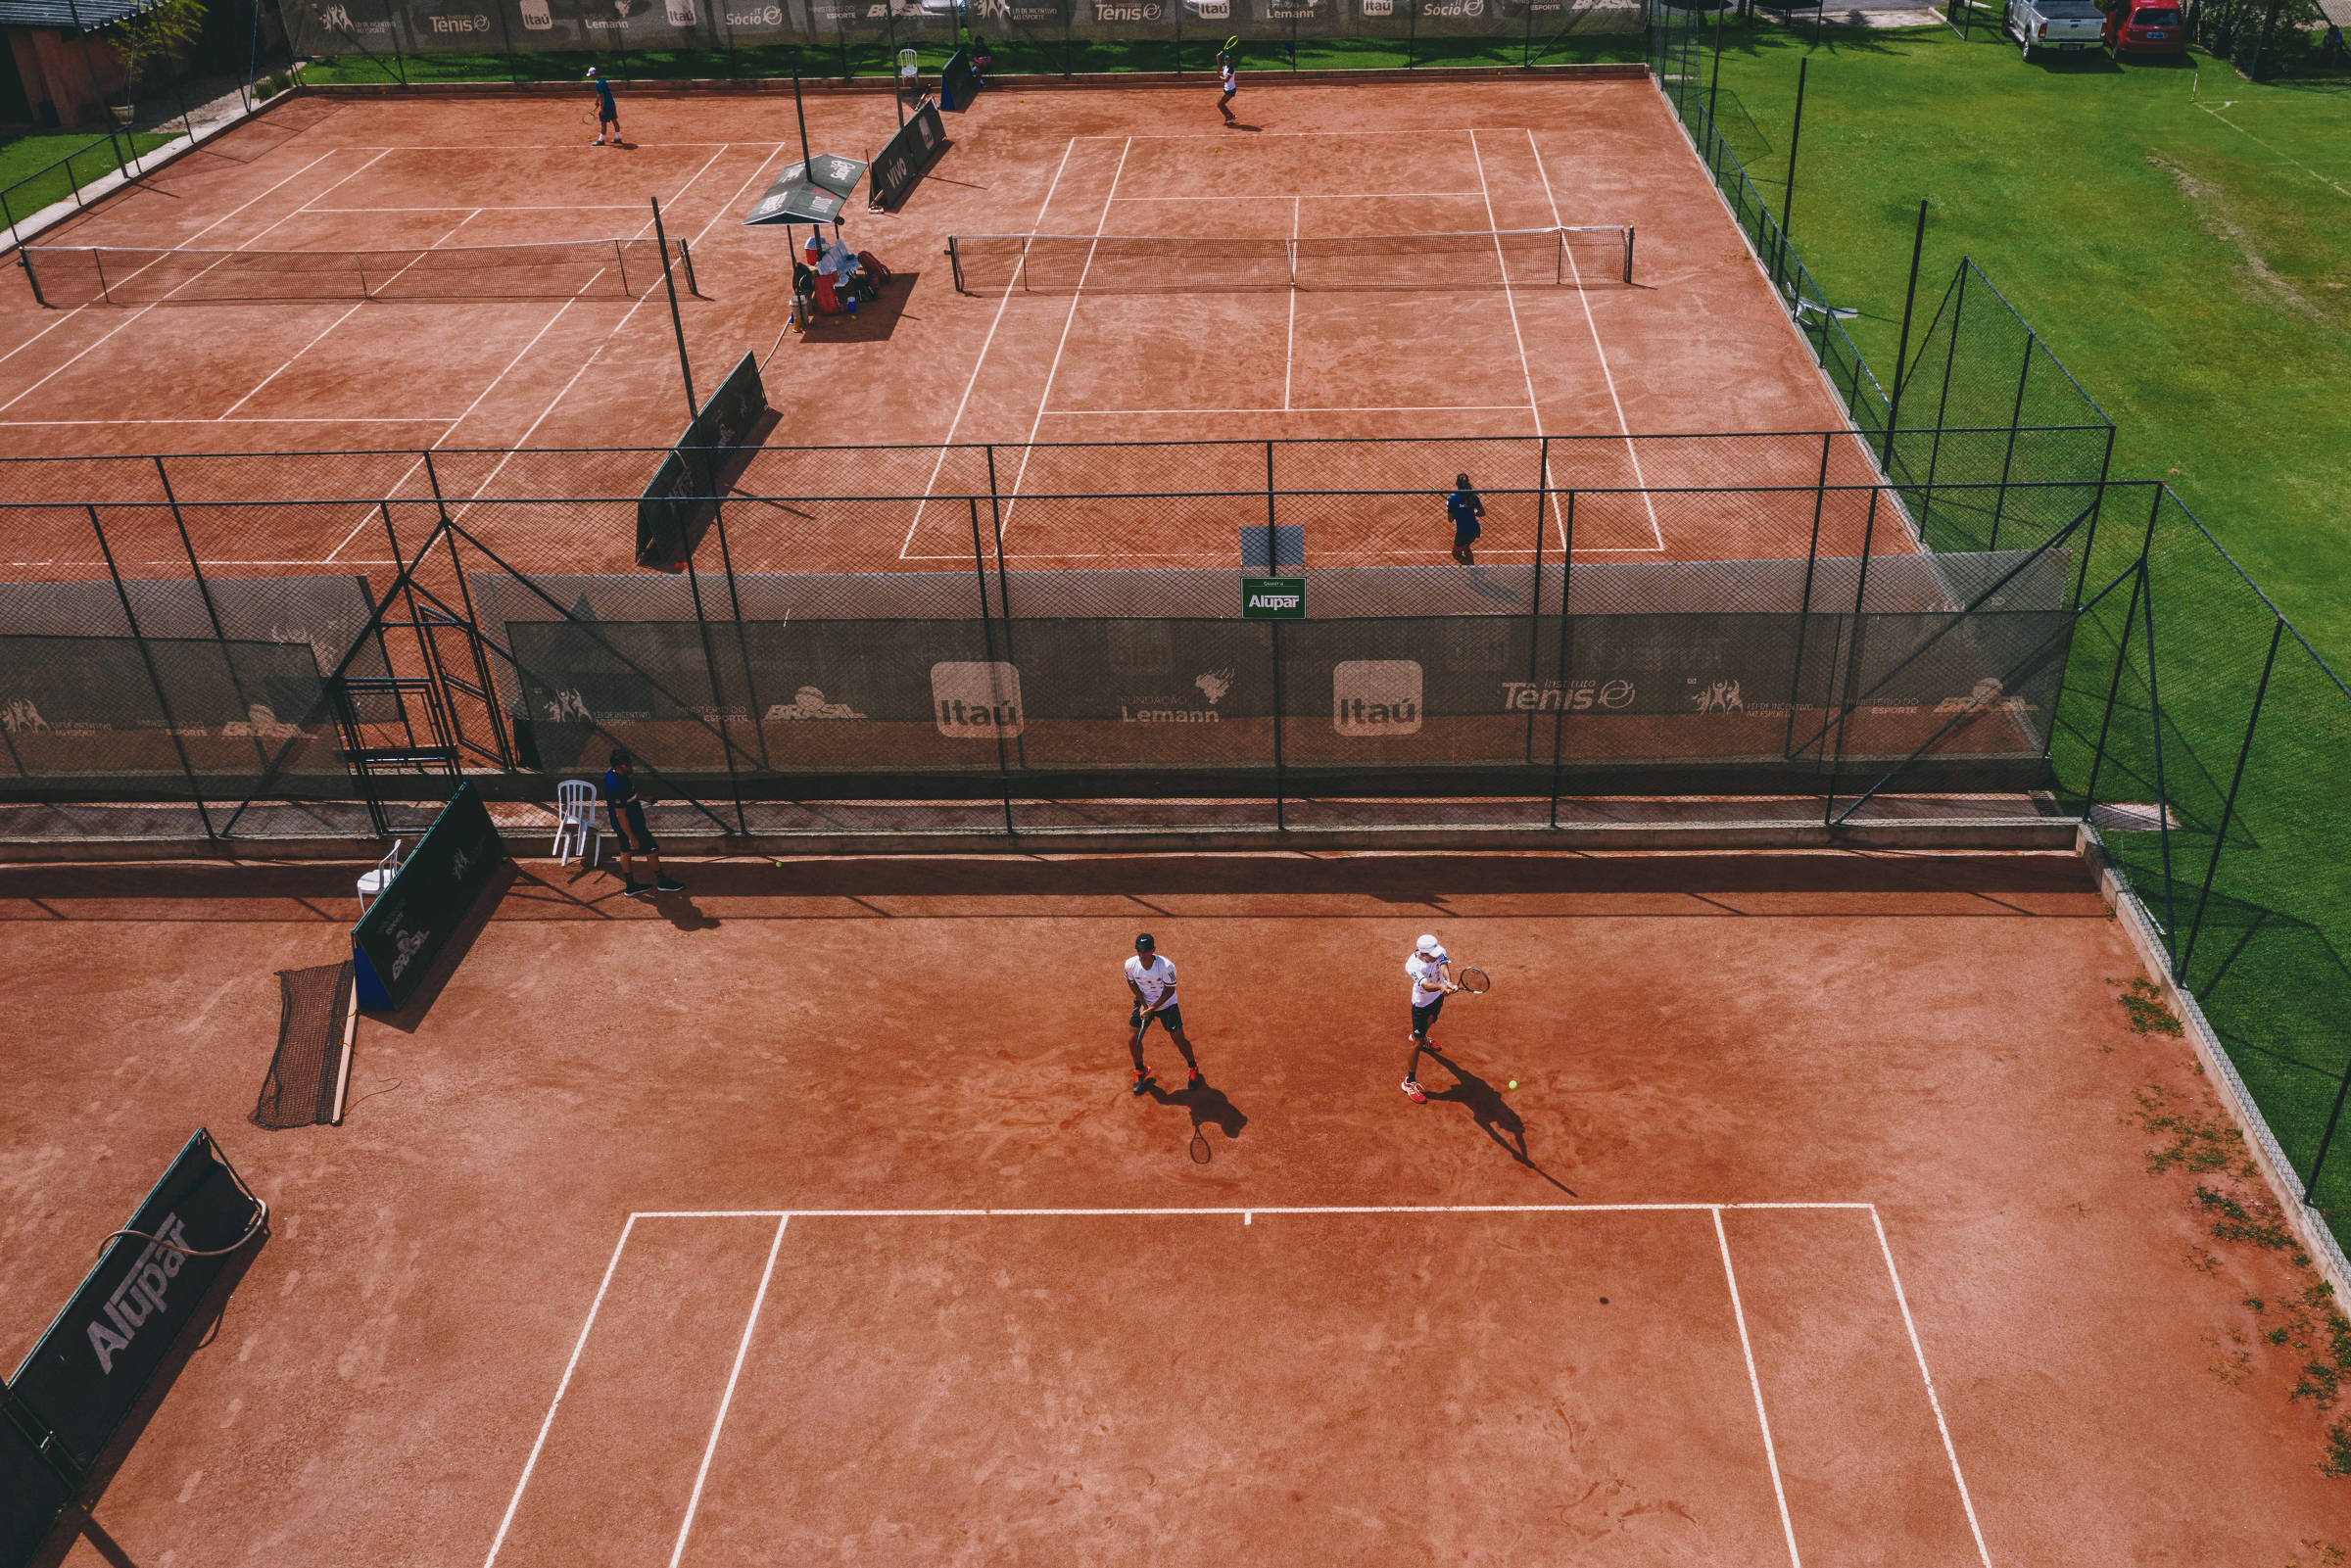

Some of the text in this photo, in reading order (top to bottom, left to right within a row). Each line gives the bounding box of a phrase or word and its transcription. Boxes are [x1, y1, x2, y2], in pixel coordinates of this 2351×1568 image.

[669, 11, 695, 22] Itaú
[1095, 4, 1142, 21] Tênis
[1200, 3, 1228, 15] Itaú
[1266, 8, 1315, 19] Lemann
[1422, 3, 1461, 16] Sócio
[429, 15, 473, 32] Tênis
[524, 14, 550, 25] Itaú
[586, 19, 629, 29] Lemann
[725, 13, 762, 25] Sócio
[887, 157, 907, 189] vivo
[1248, 594, 1300, 611] Alupar
[1502, 682, 1596, 711] Tênis
[703, 713, 748, 722] ESPORTE
[940, 699, 1018, 727] Itaú
[1122, 705, 1220, 723] Lemann
[1340, 697, 1415, 725] Itaú
[1872, 706, 1918, 715] ESPORTE
[86, 1211, 191, 1376] Alupar
